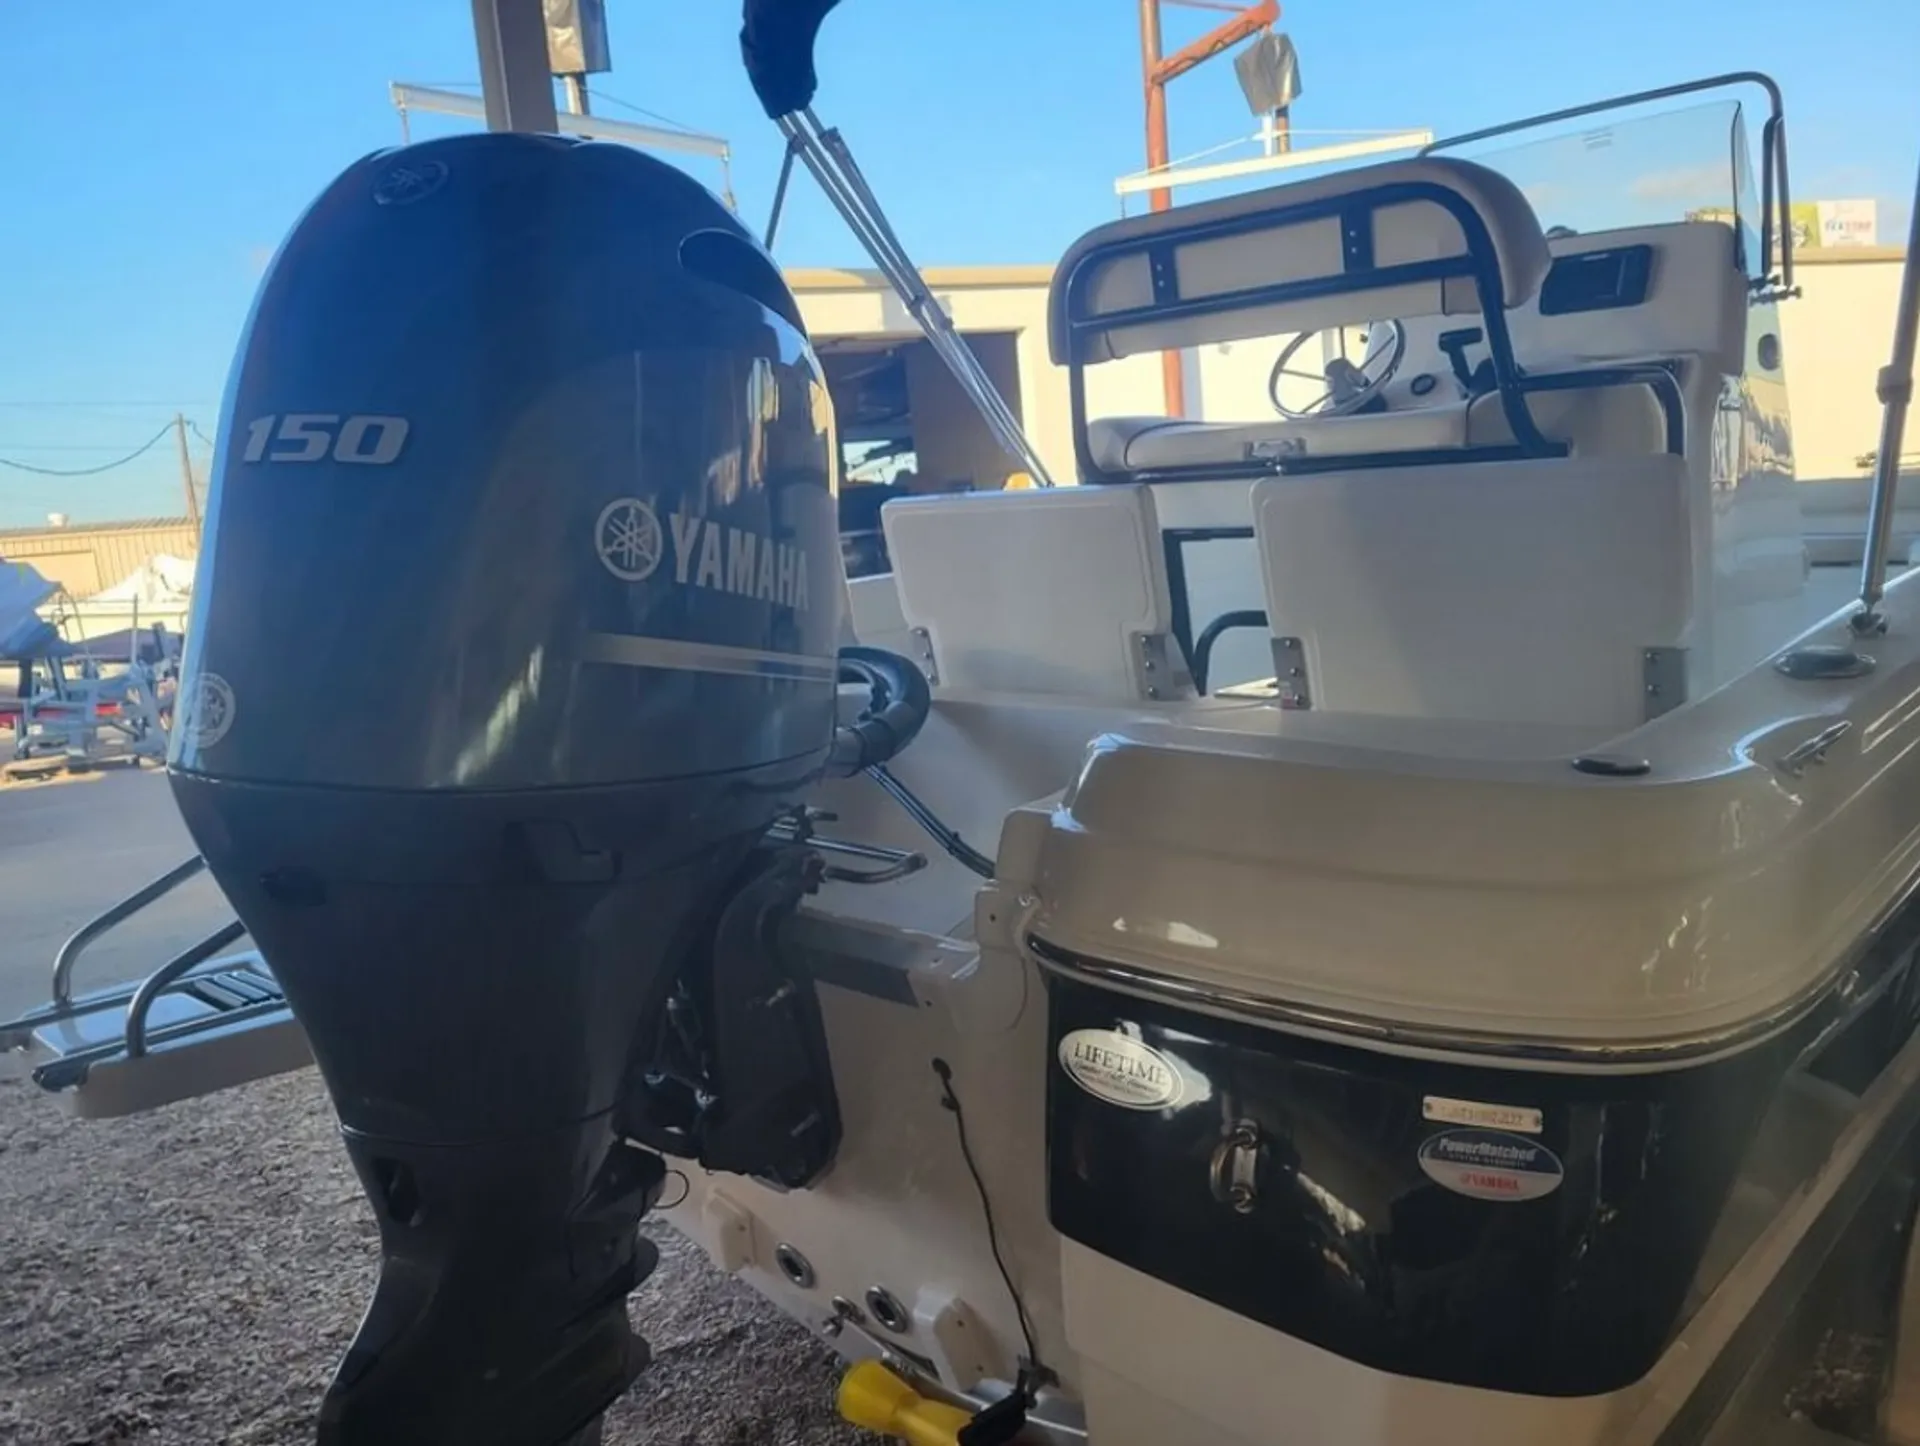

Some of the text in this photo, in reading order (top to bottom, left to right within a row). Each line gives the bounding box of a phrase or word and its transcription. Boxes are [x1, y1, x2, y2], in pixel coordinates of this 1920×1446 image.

[242, 414, 409, 464] 150
[669, 513, 808, 611] YAMAHA
[1074, 1041, 1167, 1085] LIFETIME
[1440, 1138, 1538, 1161] PowerMatched
